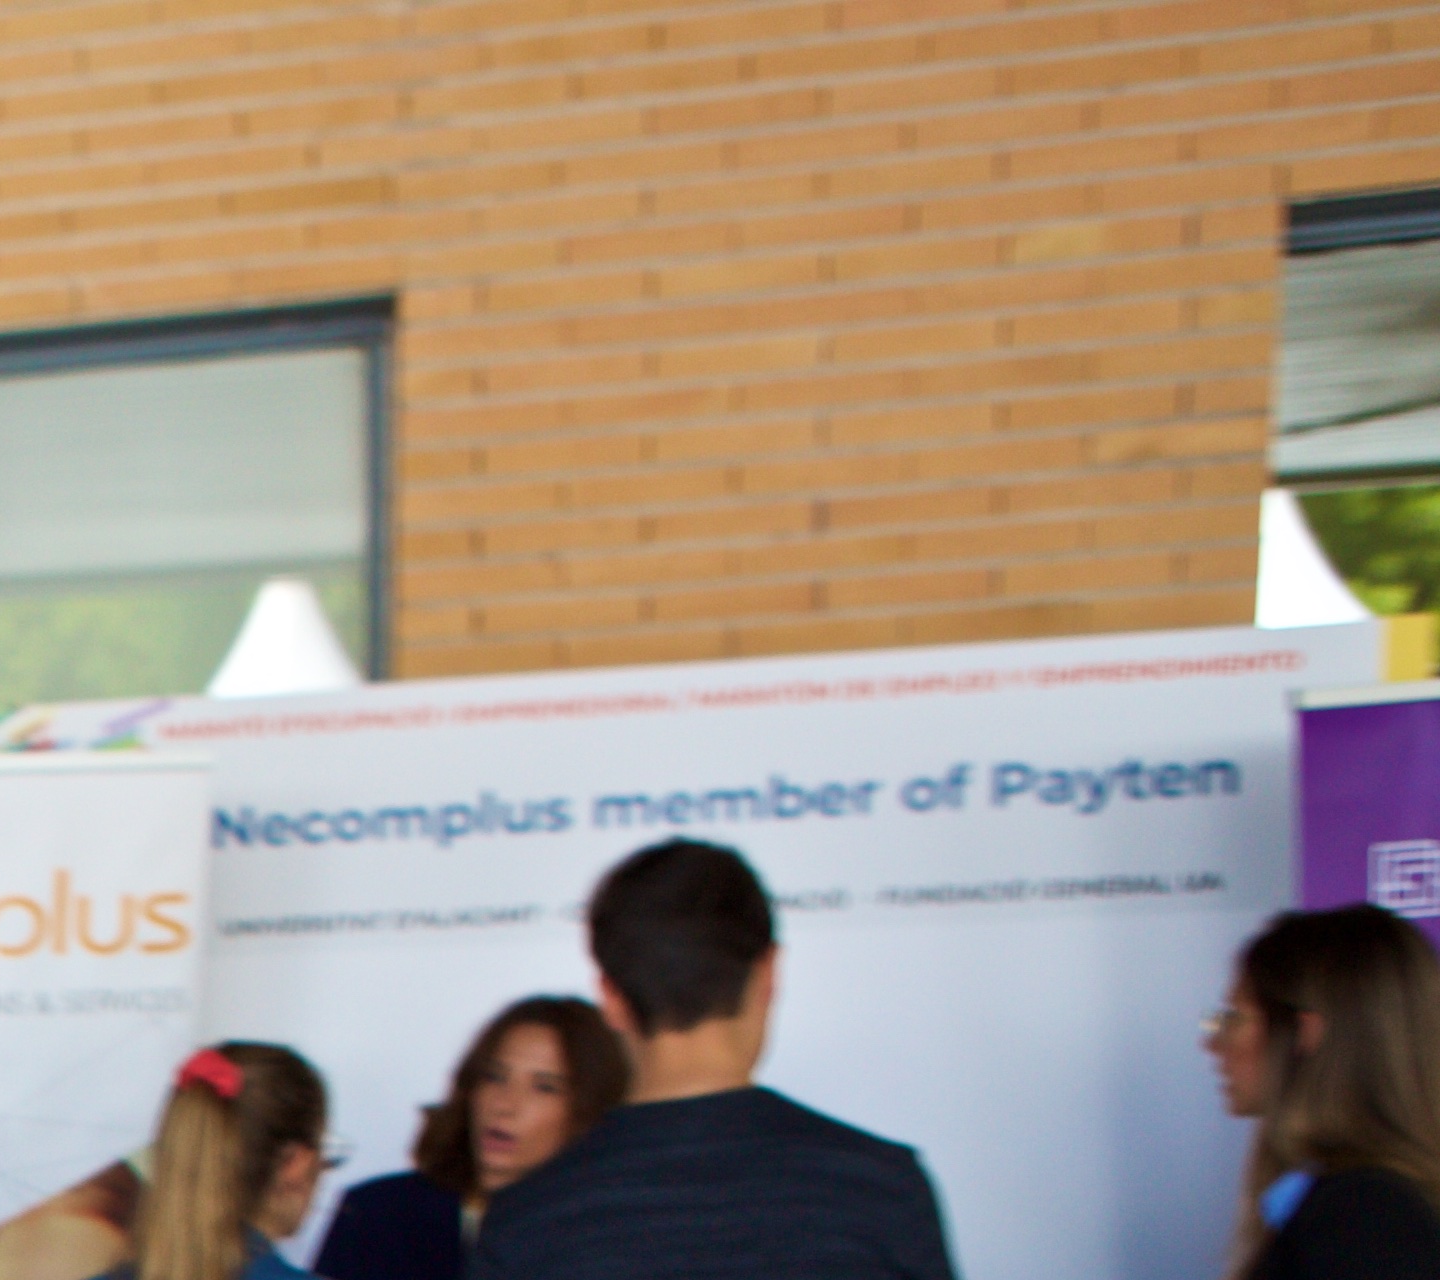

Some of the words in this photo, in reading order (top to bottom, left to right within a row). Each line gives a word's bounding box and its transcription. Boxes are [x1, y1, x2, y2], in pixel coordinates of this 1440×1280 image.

[211, 793, 574, 850] Necomplus
[592, 774, 880, 828] member
[901, 763, 973, 812] of
[991, 757, 1240, 814] Payten
